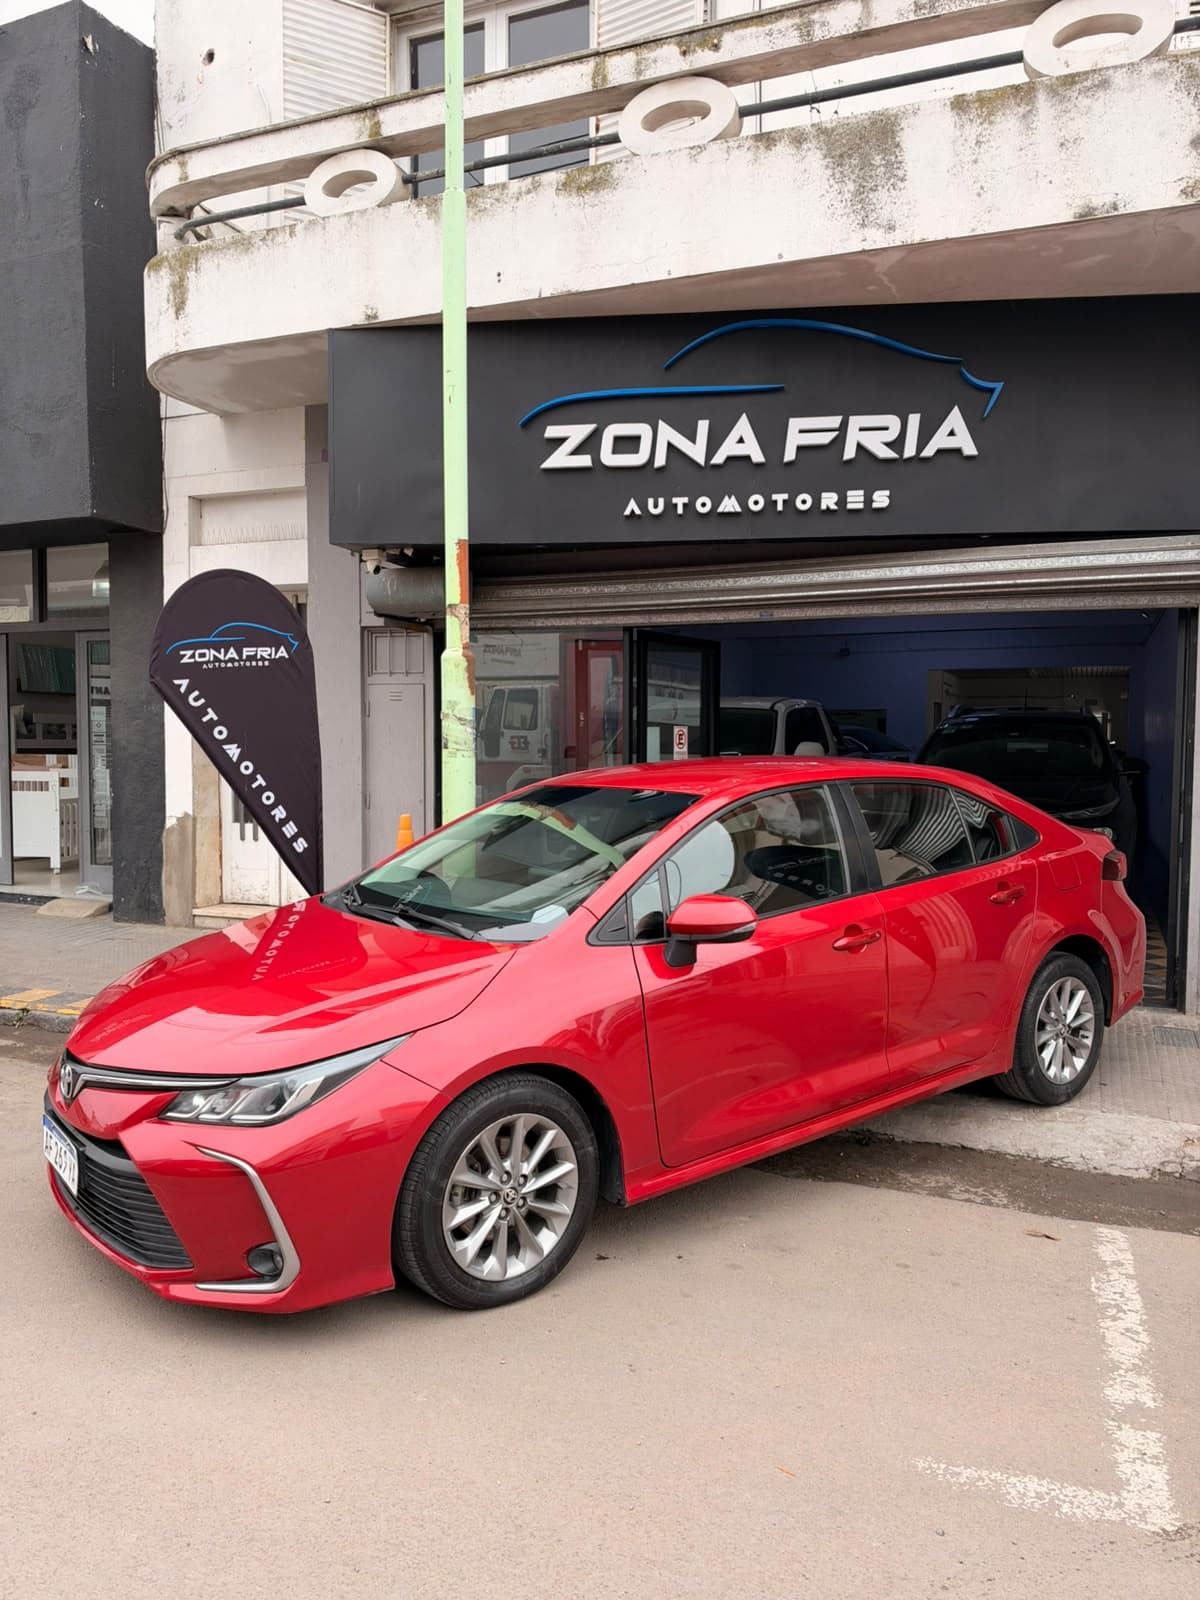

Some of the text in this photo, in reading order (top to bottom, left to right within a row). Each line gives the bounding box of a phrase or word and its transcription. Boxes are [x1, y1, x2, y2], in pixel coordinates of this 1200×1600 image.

[540, 404, 979, 469] ZONA FRIA
[623, 489, 891, 517] AUTOMOTORES
[179, 645, 289, 664] ZONA FRIA
[202, 661, 270, 669] AUTOMOTORES
[172, 678, 309, 854] AUTOMOTORES
